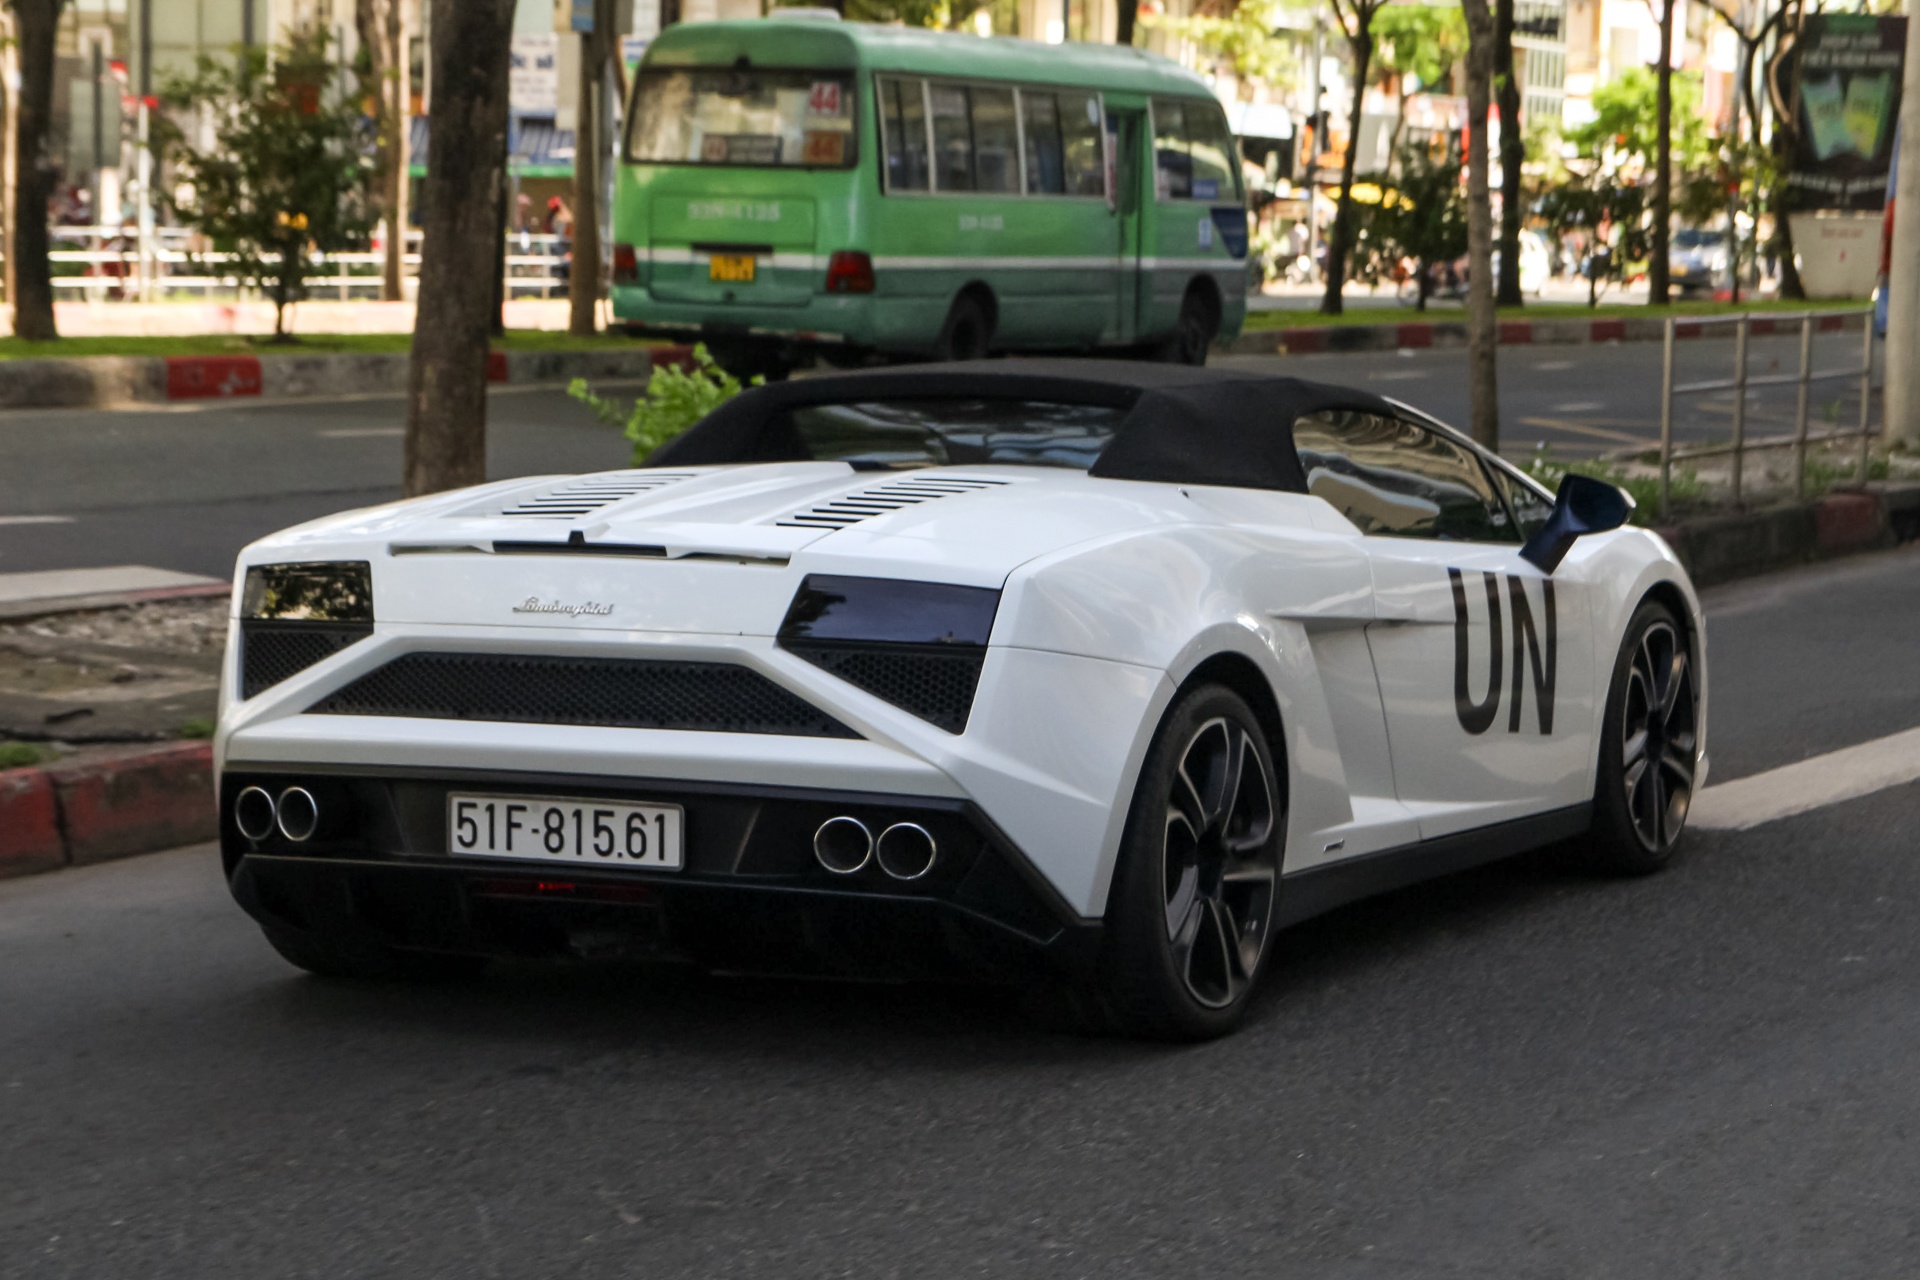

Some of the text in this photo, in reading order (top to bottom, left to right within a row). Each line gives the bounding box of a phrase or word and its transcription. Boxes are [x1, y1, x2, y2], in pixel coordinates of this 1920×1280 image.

[810, 83, 839, 112] 44
[1447, 566, 1557, 736] UN
[457, 801, 666, 861] 51F-815.61
